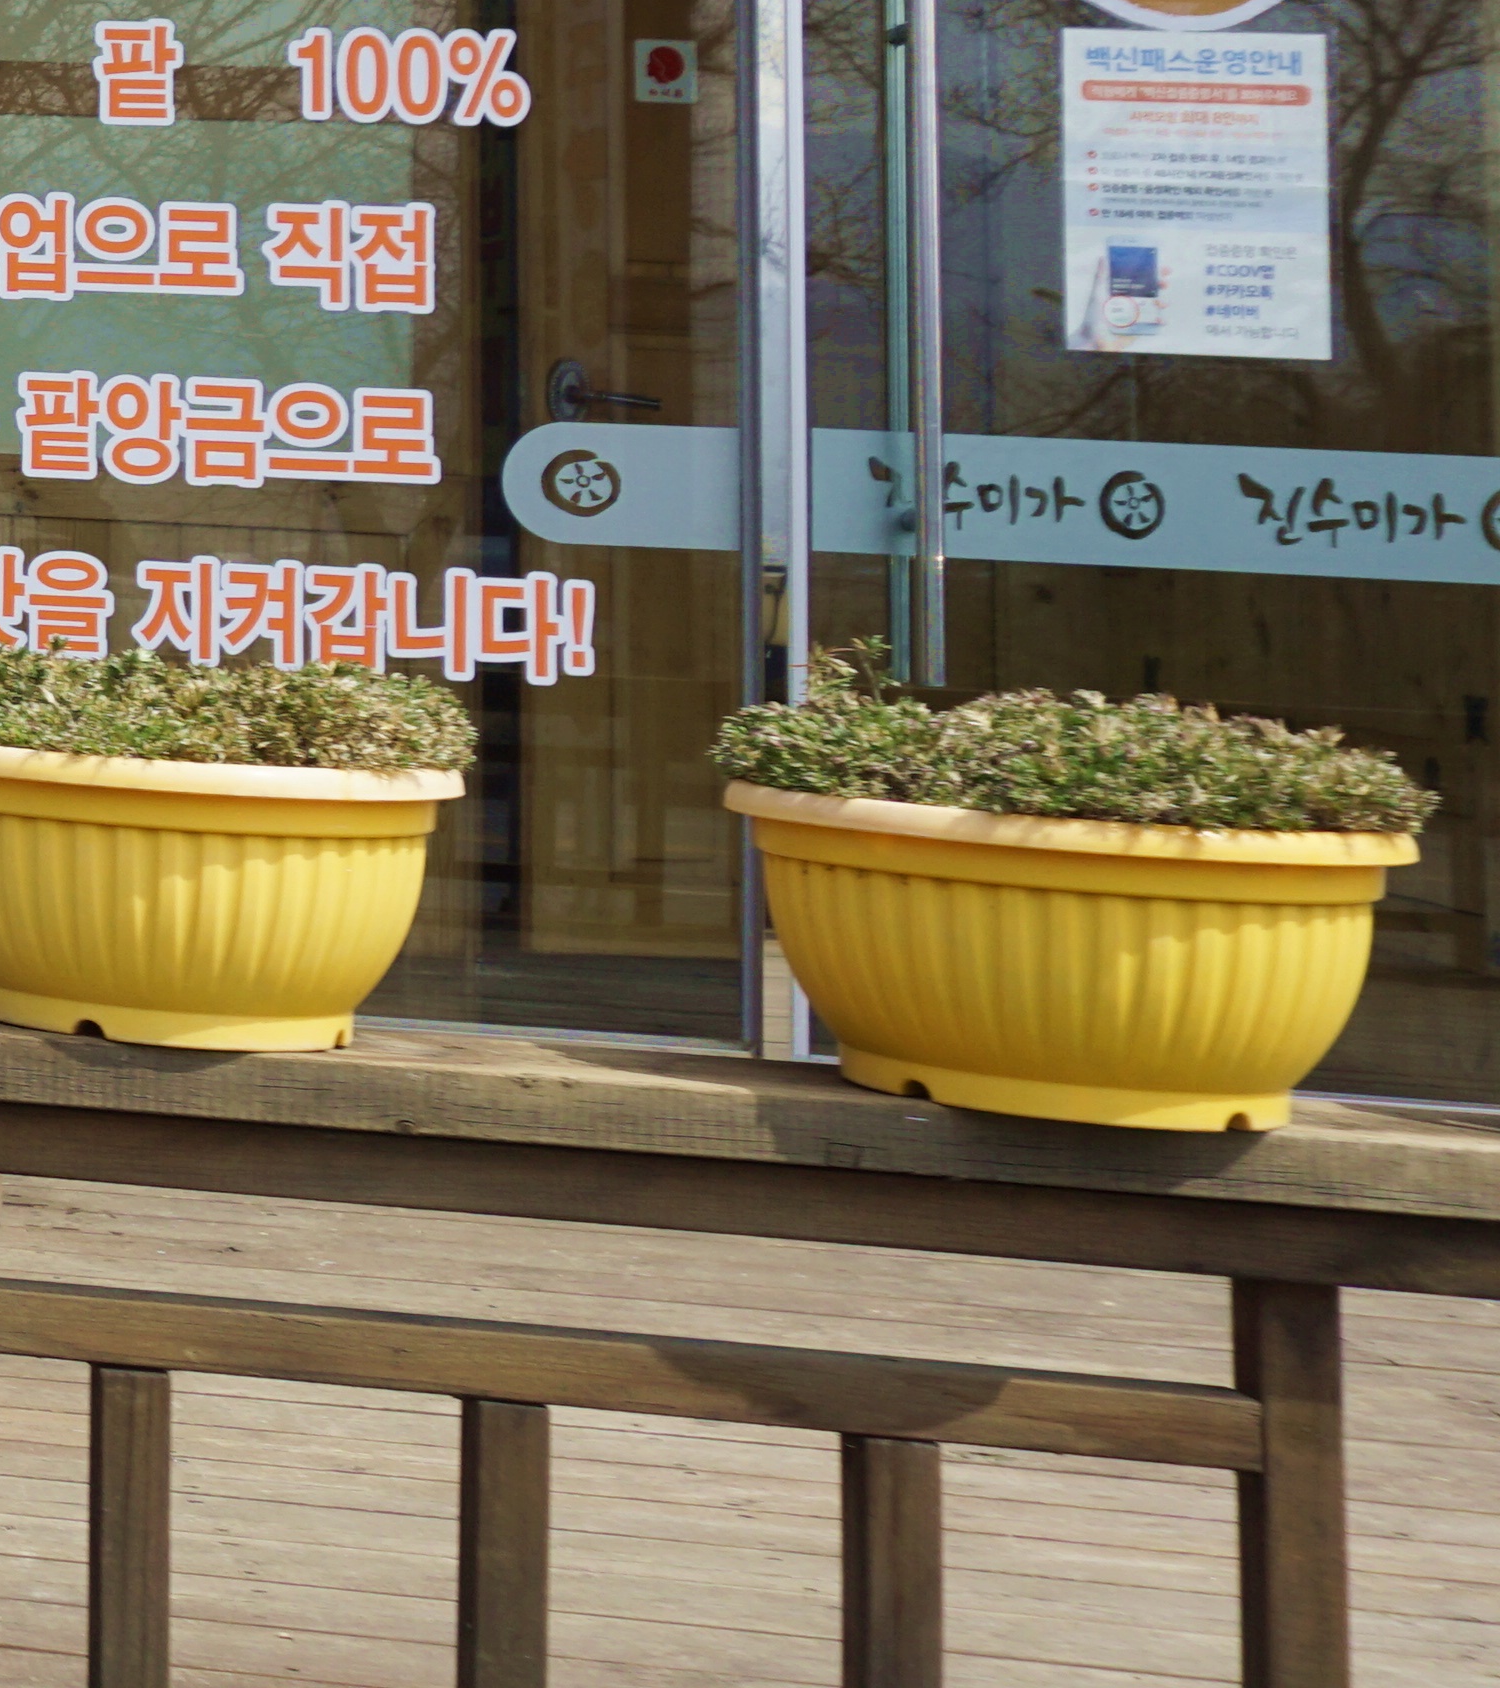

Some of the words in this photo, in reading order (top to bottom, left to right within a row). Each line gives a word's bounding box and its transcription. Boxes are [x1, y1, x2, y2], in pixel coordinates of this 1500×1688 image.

[95, 18, 183, 126] 팥
[287, 26, 531, 128] 100%
[265, 201, 437, 312] 직접
[16, 365, 440, 485] 팥앙금으로
[1238, 472, 1467, 548] 진수미가
[131, 555, 595, 686] 지켜갑니다!
